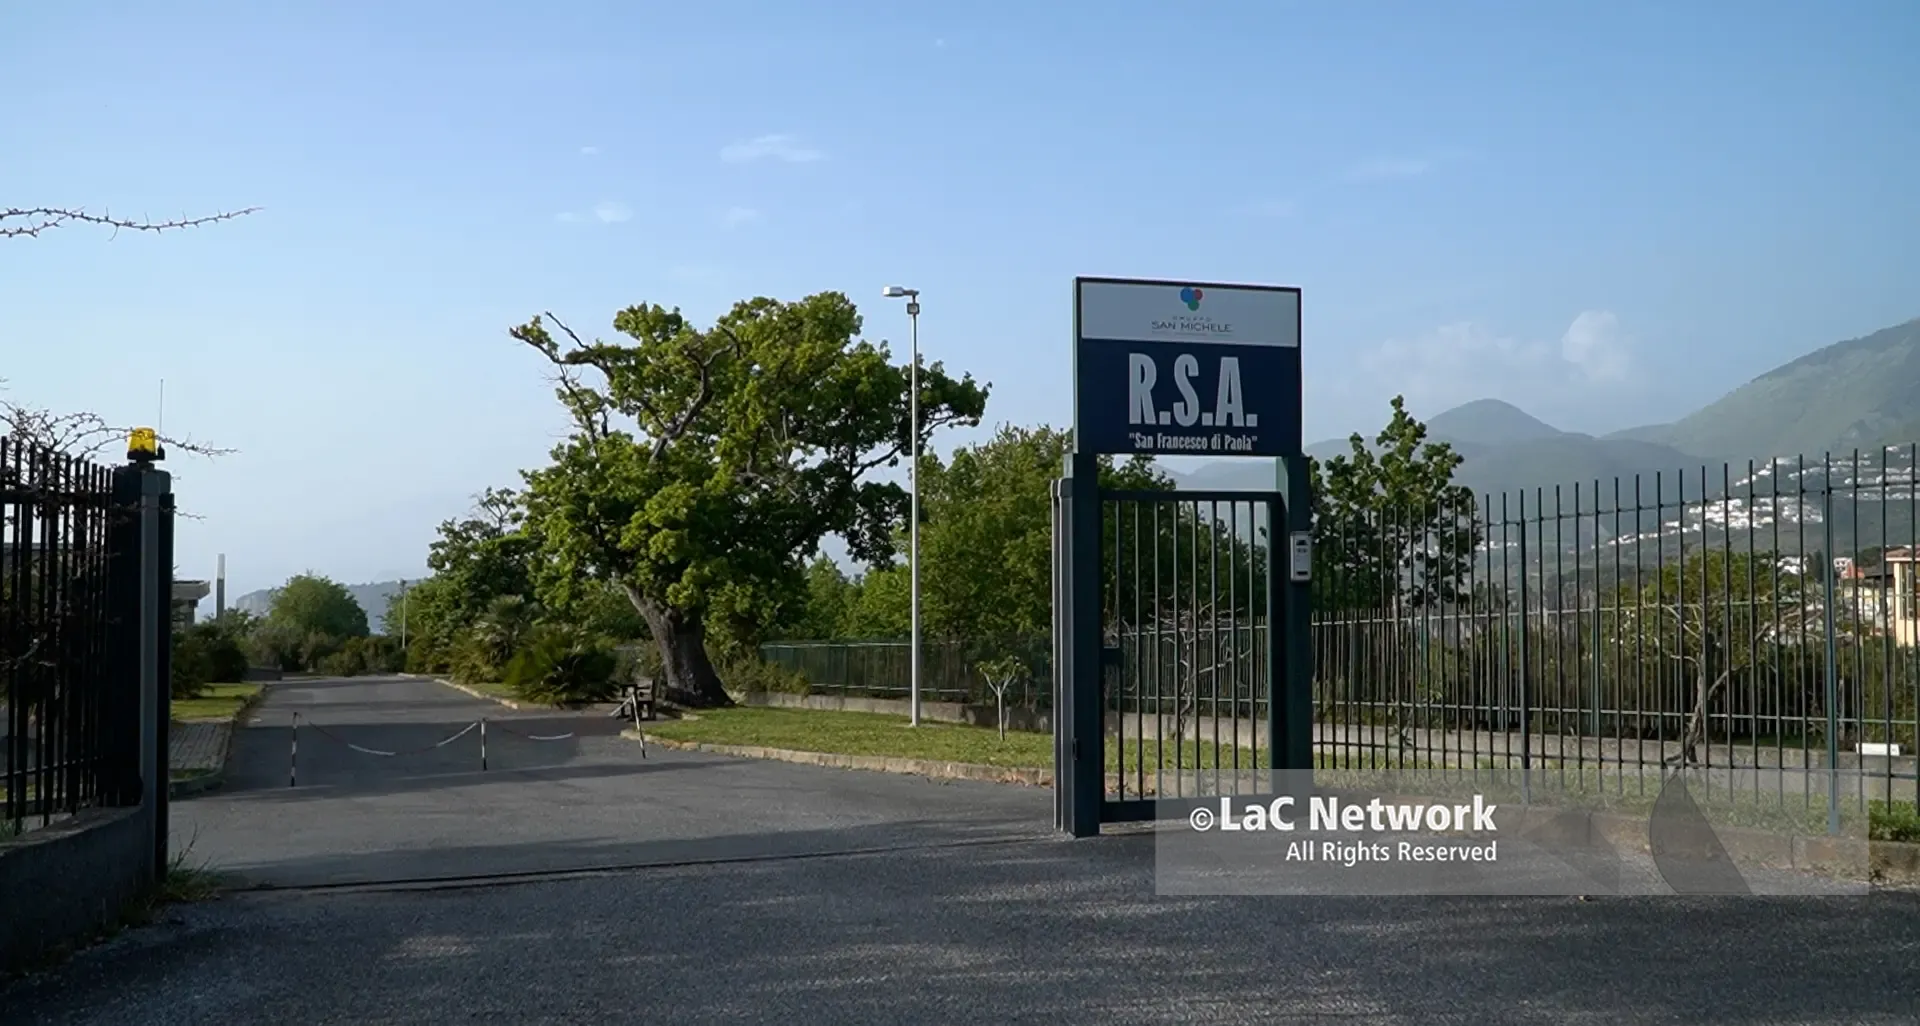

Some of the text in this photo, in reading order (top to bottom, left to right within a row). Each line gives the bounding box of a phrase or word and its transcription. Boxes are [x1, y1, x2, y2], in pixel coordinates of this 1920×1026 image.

[1151, 320, 1233, 333] SAN MICHELE
[1129, 353, 1258, 427] R.S.A.
[1129, 432, 1258, 451] "San Francesco di Paola"
